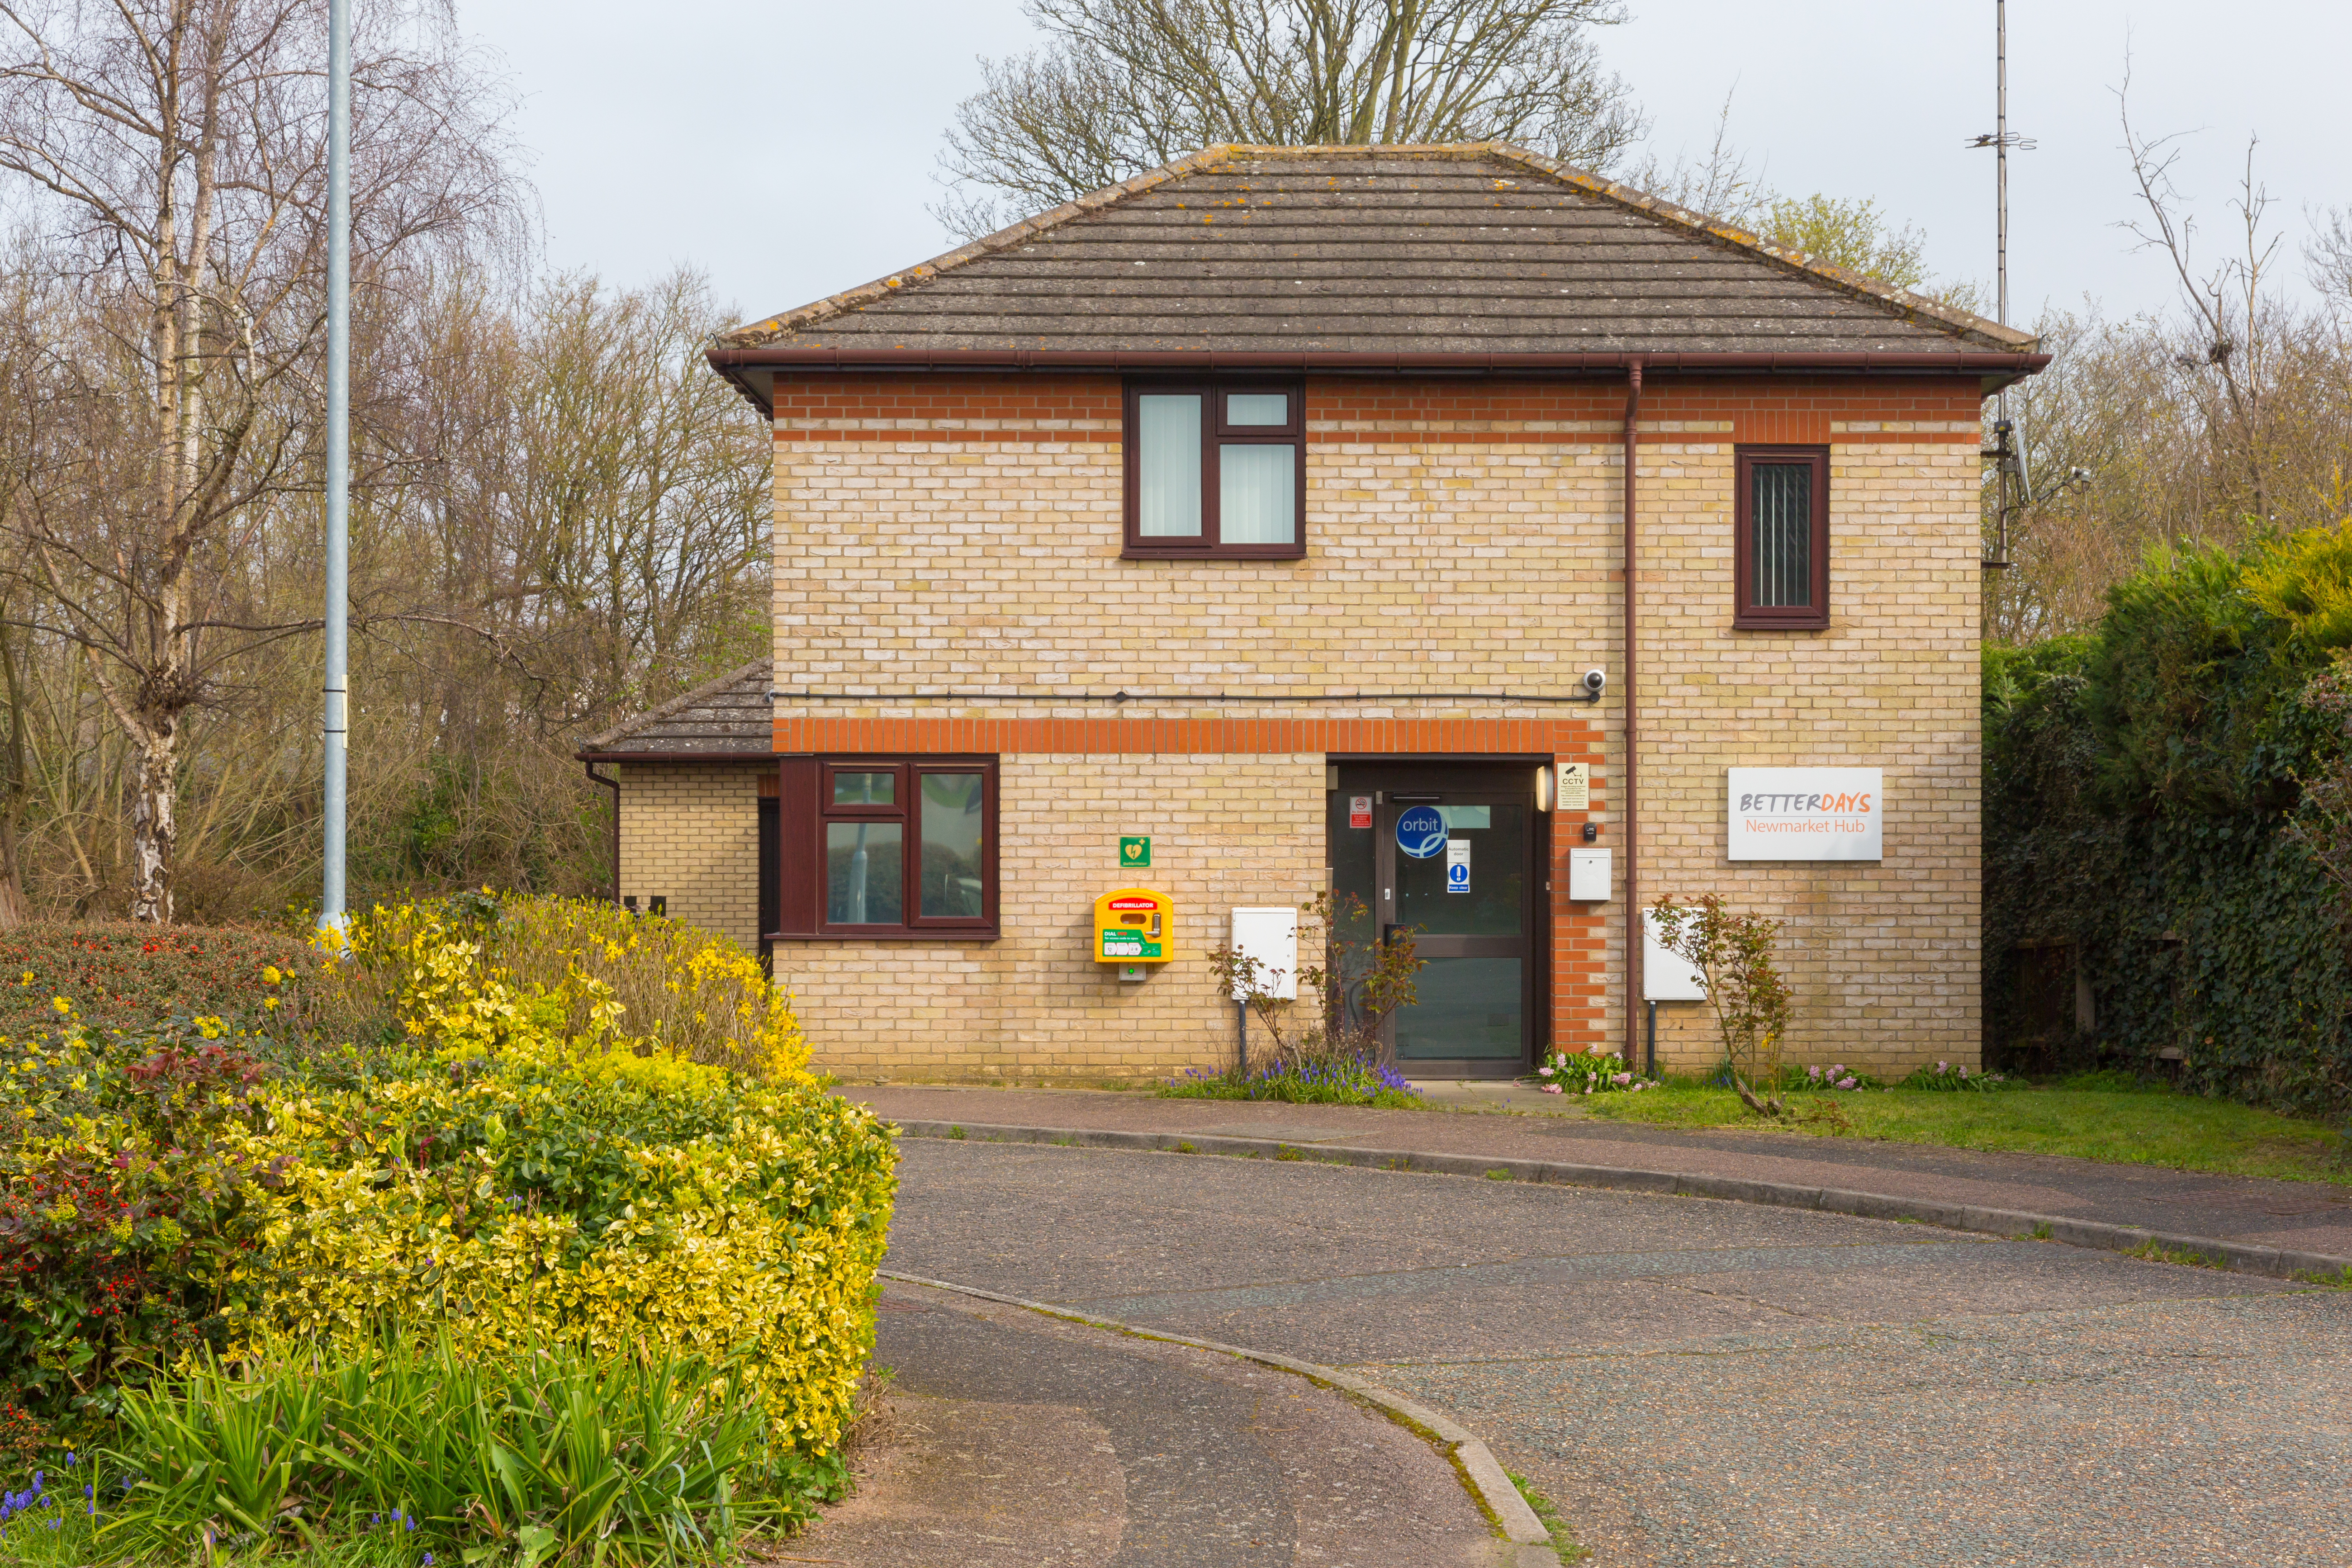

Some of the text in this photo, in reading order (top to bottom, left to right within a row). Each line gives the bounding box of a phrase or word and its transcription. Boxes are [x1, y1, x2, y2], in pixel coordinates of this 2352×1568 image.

[1740, 792, 1871, 813] BETTERDAYS
[1403, 818, 1438, 831] orbit
[1746, 819, 1865, 833] Newmarket Hub
